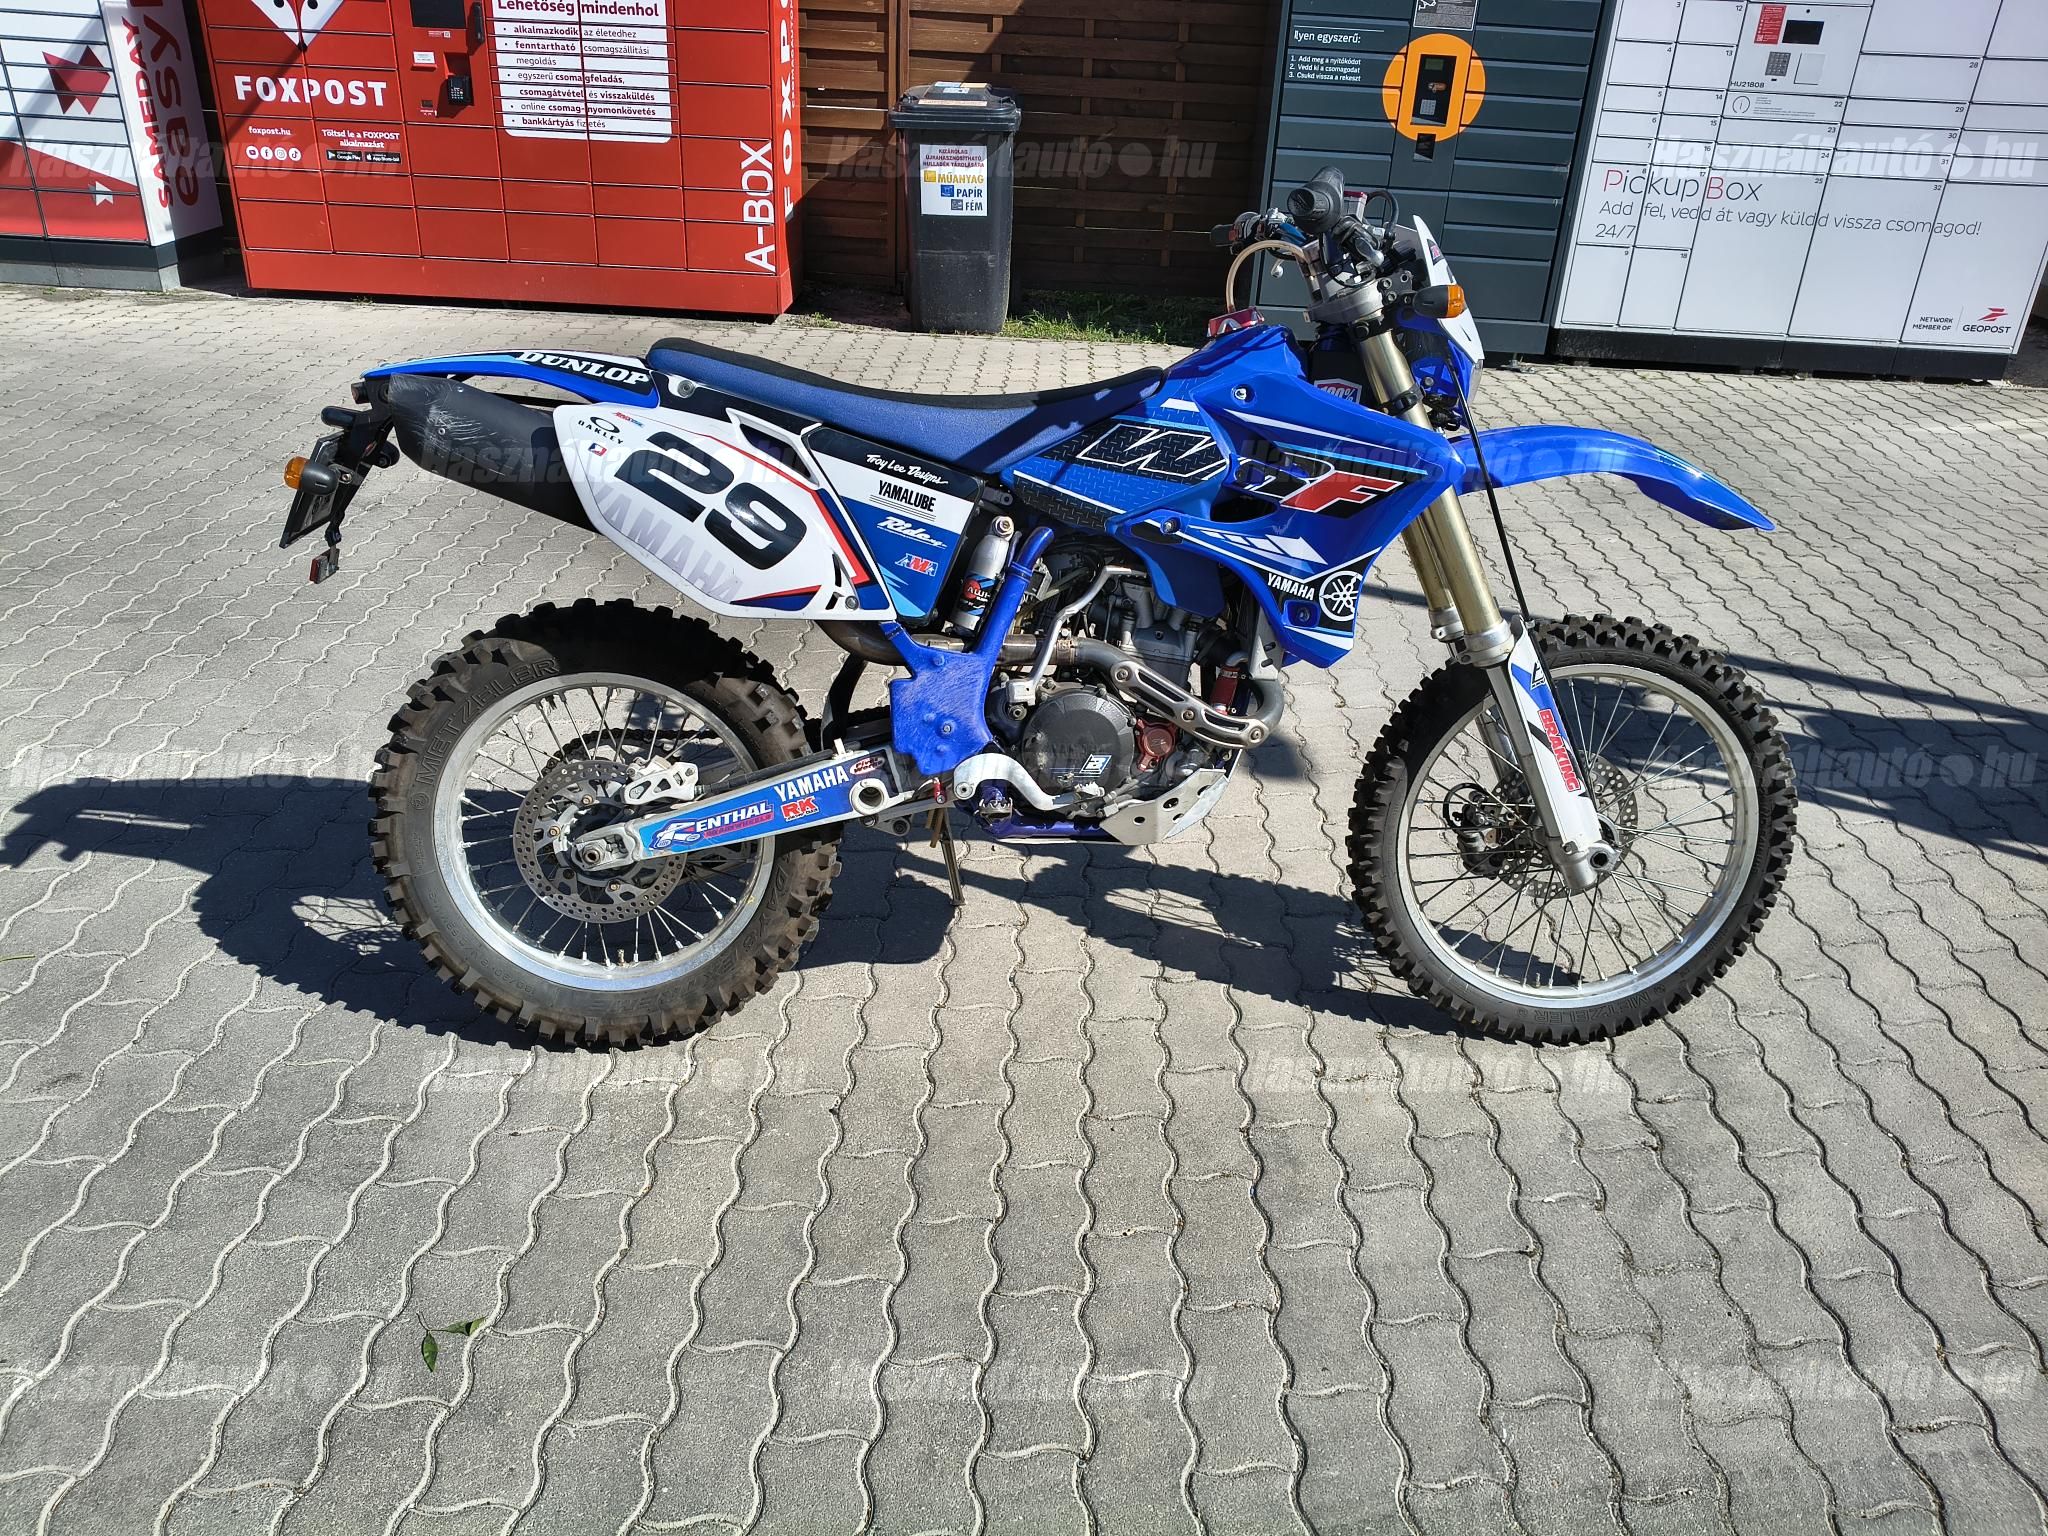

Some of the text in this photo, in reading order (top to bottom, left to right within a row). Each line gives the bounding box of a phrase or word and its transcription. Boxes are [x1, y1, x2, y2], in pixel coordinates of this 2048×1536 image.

[582, 1, 660, 17] mindenhol
[514, 26, 579, 36] alkalmazkodik
[596, 28, 637, 38] életedhez
[1294, 30, 1361, 44] Ilyen egyszerű:
[515, 41, 650, 55] fenntartható csomagszállítási
[516, 57, 557, 67] megoldás
[1325, 66, 1360, 74] csomagodat
[518, 71, 554, 81] egyszerű
[234, 75, 387, 107] FOXPOST
[519, 88, 655, 101] csomagátvétel és visszaküldés
[121, 16, 174, 209] SAMEDAY
[131, 0, 200, 207] easy
[779, 0, 794, 219] FOXP
[248, 126, 291, 136] foxpost.hu
[522, 117, 575, 128] bankkártyás
[347, 130, 355, 138] le
[363, 131, 400, 140] FOXPOST
[938, 172, 984, 184] MŰANYAG
[1603, 169, 1763, 202] Pickup Box
[956, 186, 983, 198] PAPÍR
[740, 140, 776, 273] A-BOX
[965, 200, 983, 211] FÉM
[1599, 201, 1983, 237] Add fel, vedd át vagy küldd vissza csomagod!
[1595, 223, 1637, 239] 24/7
[1919, 316, 1954, 324] NETWORK
[1962, 324, 2011, 334] GEOPOST
[516, 351, 650, 385] DUNLOP
[578, 420, 624, 444] OAKLEY
[866, 454, 949, 485] Troy Lee Designs
[614, 431, 807, 571] 29
[878, 480, 937, 512] YAMALUBE
[594, 485, 745, 602] YAMAHA
[1267, 573, 1315, 601] YAMAHA
[1538, 708, 1582, 793] BRAKING
[774, 766, 850, 802] YAMAHA
[782, 797, 818, 817] RK
